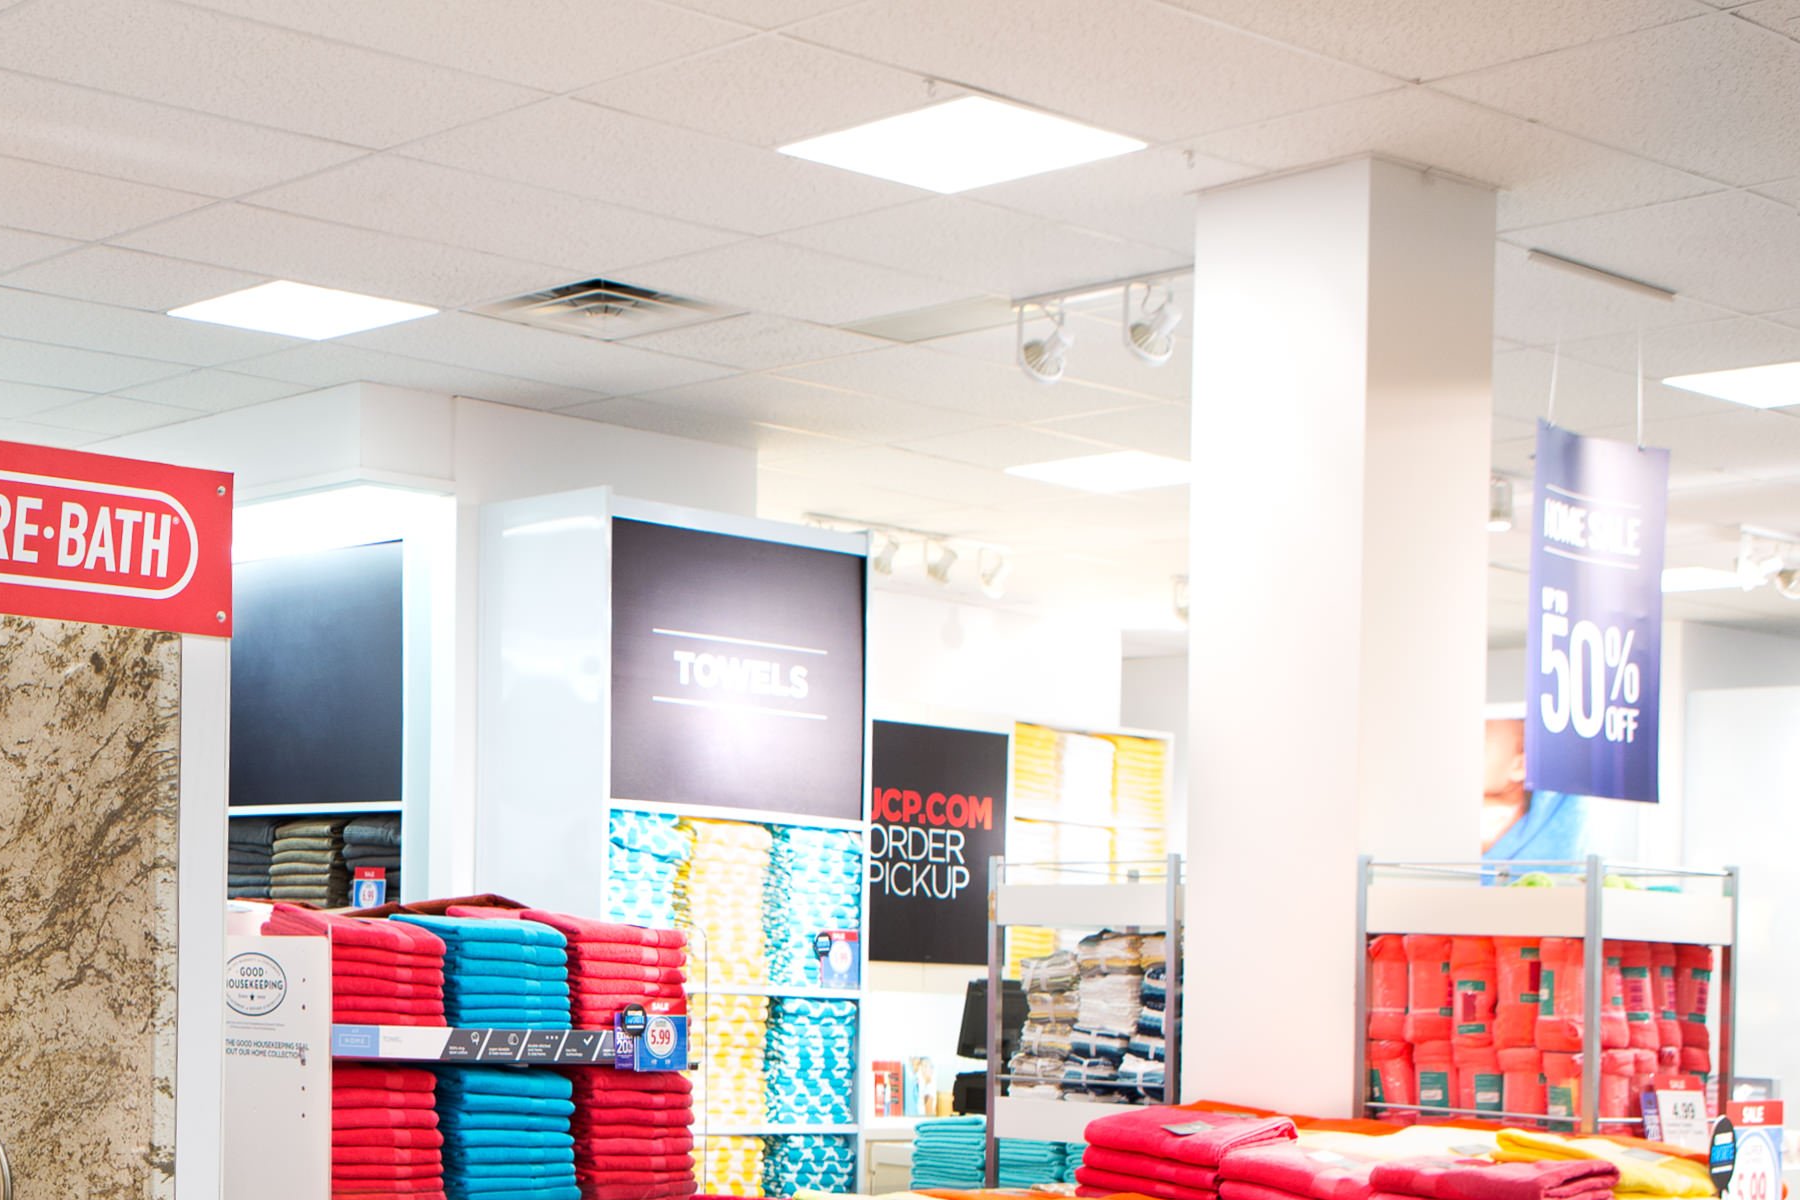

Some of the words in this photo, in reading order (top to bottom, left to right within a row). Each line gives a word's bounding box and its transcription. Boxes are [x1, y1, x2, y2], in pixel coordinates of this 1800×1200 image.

[673, 649, 809, 699] TOWELS
[1541, 612, 1640, 738] 50%
[1605, 706, 1639, 743] OFF
[871, 787, 992, 830] JCP.COM
[870, 823, 965, 864] ORDER
[870, 860, 970, 899] PICKUP
[240, 967, 264, 976] GOOD
[651, 1002, 669, 1011] SALE
[651, 1030, 670, 1045] 5.99
[1742, 1106, 1765, 1123] SALE
